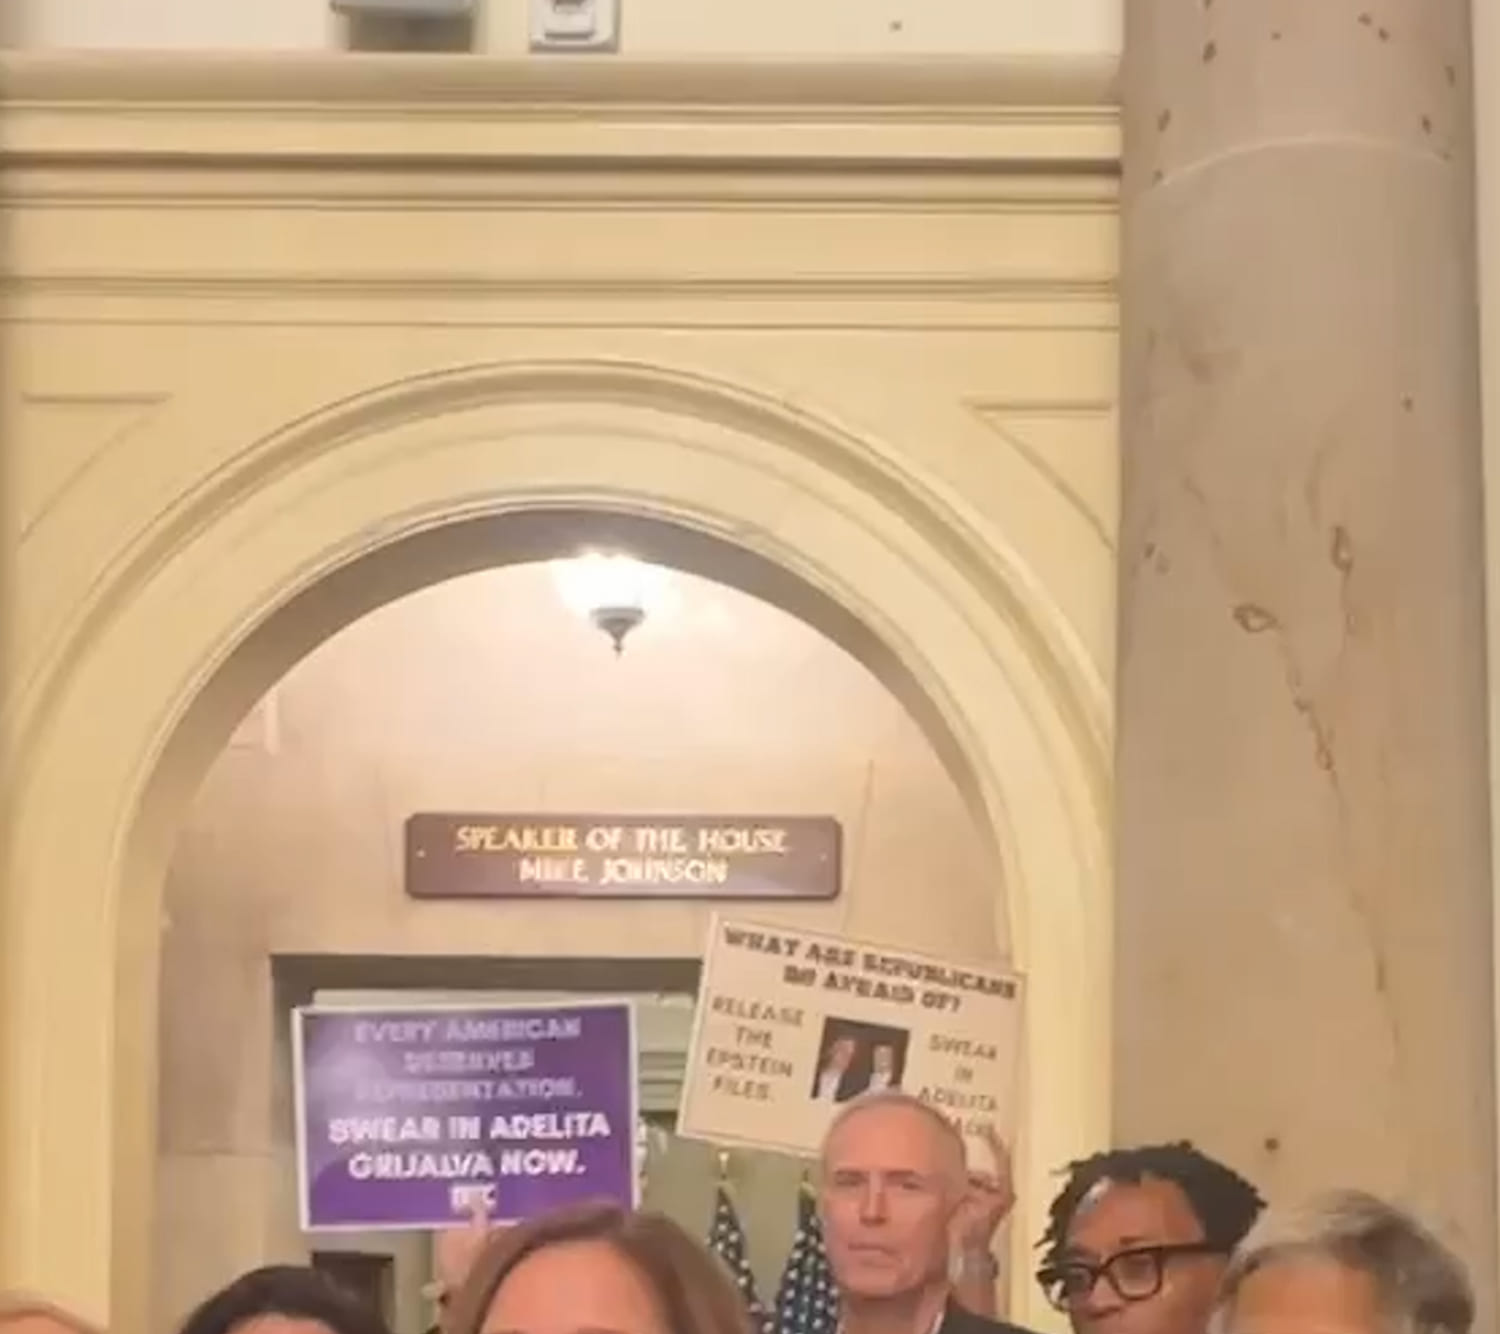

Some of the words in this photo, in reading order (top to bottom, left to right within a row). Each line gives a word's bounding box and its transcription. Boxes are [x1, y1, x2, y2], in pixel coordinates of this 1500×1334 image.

[455, 825, 578, 851] SPEAKER
[585, 826, 622, 850] OF
[633, 828, 686, 853] THE
[699, 829, 788, 854] HOUSE
[519, 858, 589, 883] MIKE
[598, 858, 728, 885] JOHNSON
[724, 927, 802, 956] WHAT
[805, 943, 857, 967] ARE
[862, 953, 1017, 1000] REPUBLICANS
[823, 970, 915, 1004] AFRAID
[920, 990, 962, 1013] OF?
[712, 996, 805, 1028] RELEASE
[355, 1020, 437, 1043] EVERY
[446, 1017, 581, 1041] AMERICAN
[735, 1025, 773, 1049] THE
[928, 1034, 998, 1060] SWEAR
[706, 1047, 792, 1078] EPSTEIN
[329, 1116, 441, 1145] SWEAR
[450, 1115, 481, 1140] IN
[490, 1112, 611, 1140] ADELITA
[349, 1152, 494, 1179] GRIJALVA
[501, 1149, 586, 1175] NOW.
